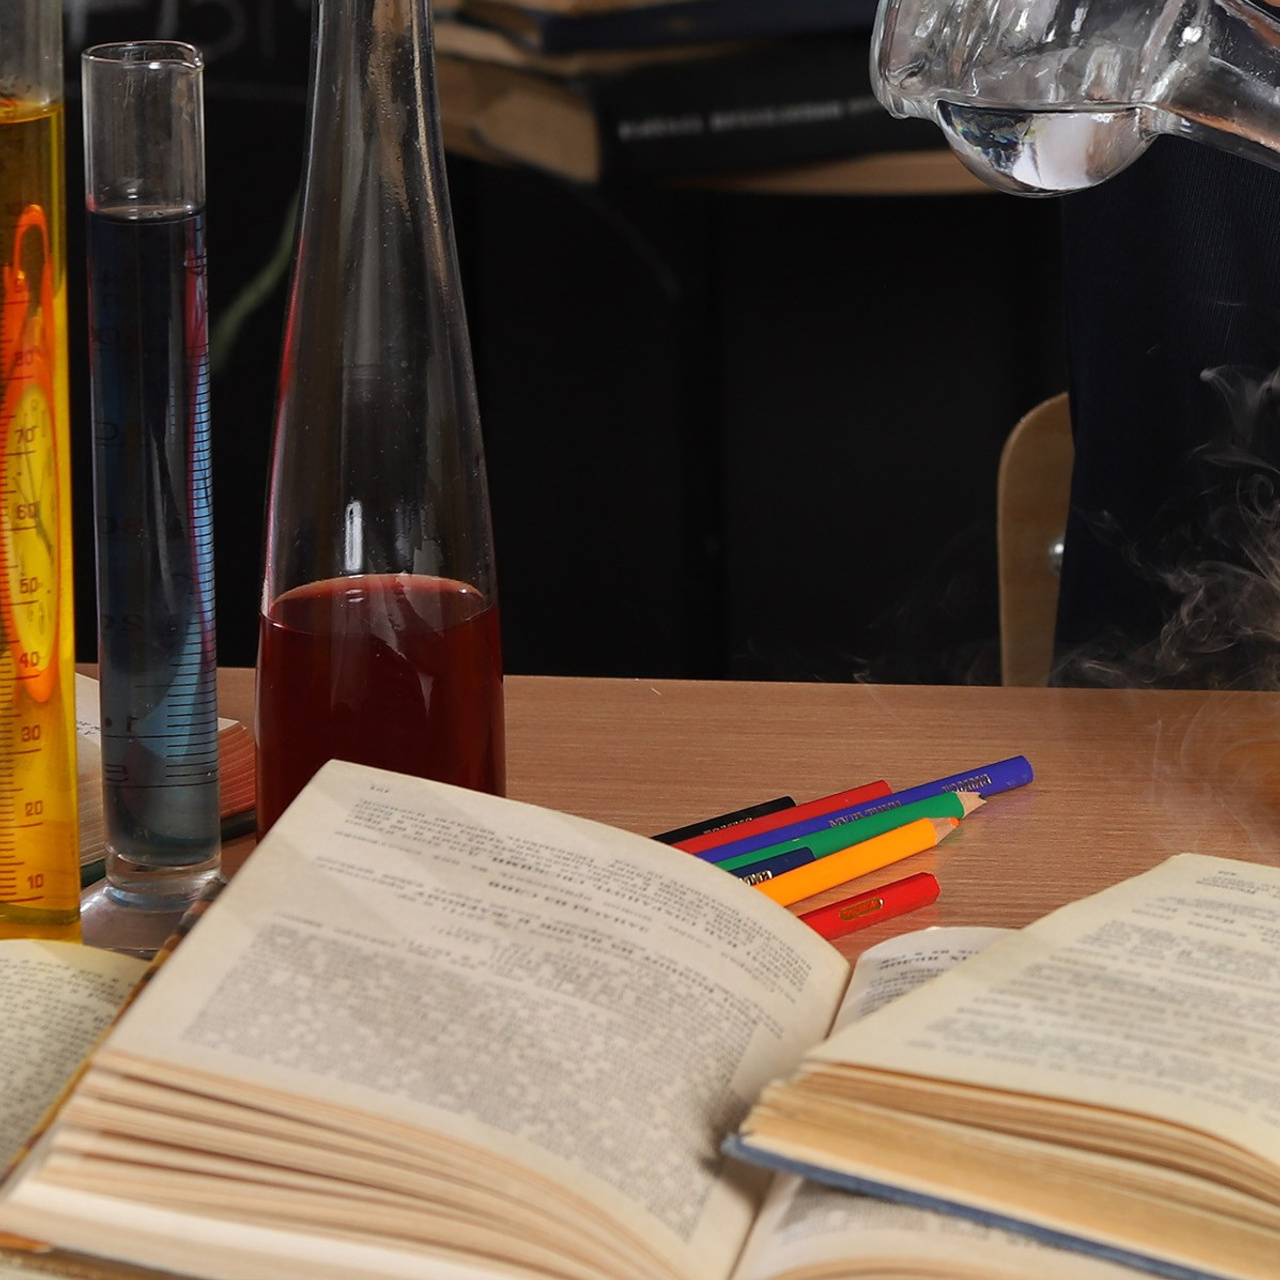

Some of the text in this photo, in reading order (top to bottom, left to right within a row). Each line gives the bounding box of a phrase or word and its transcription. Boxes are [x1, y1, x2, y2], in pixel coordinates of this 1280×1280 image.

[16, 502, 37, 521] 60
[19, 577, 38, 594] 50
[19, 651, 40, 668] 40
[21, 724, 41, 742] 30
[24, 801, 44, 817] 20
[27, 872, 44, 890] 10
